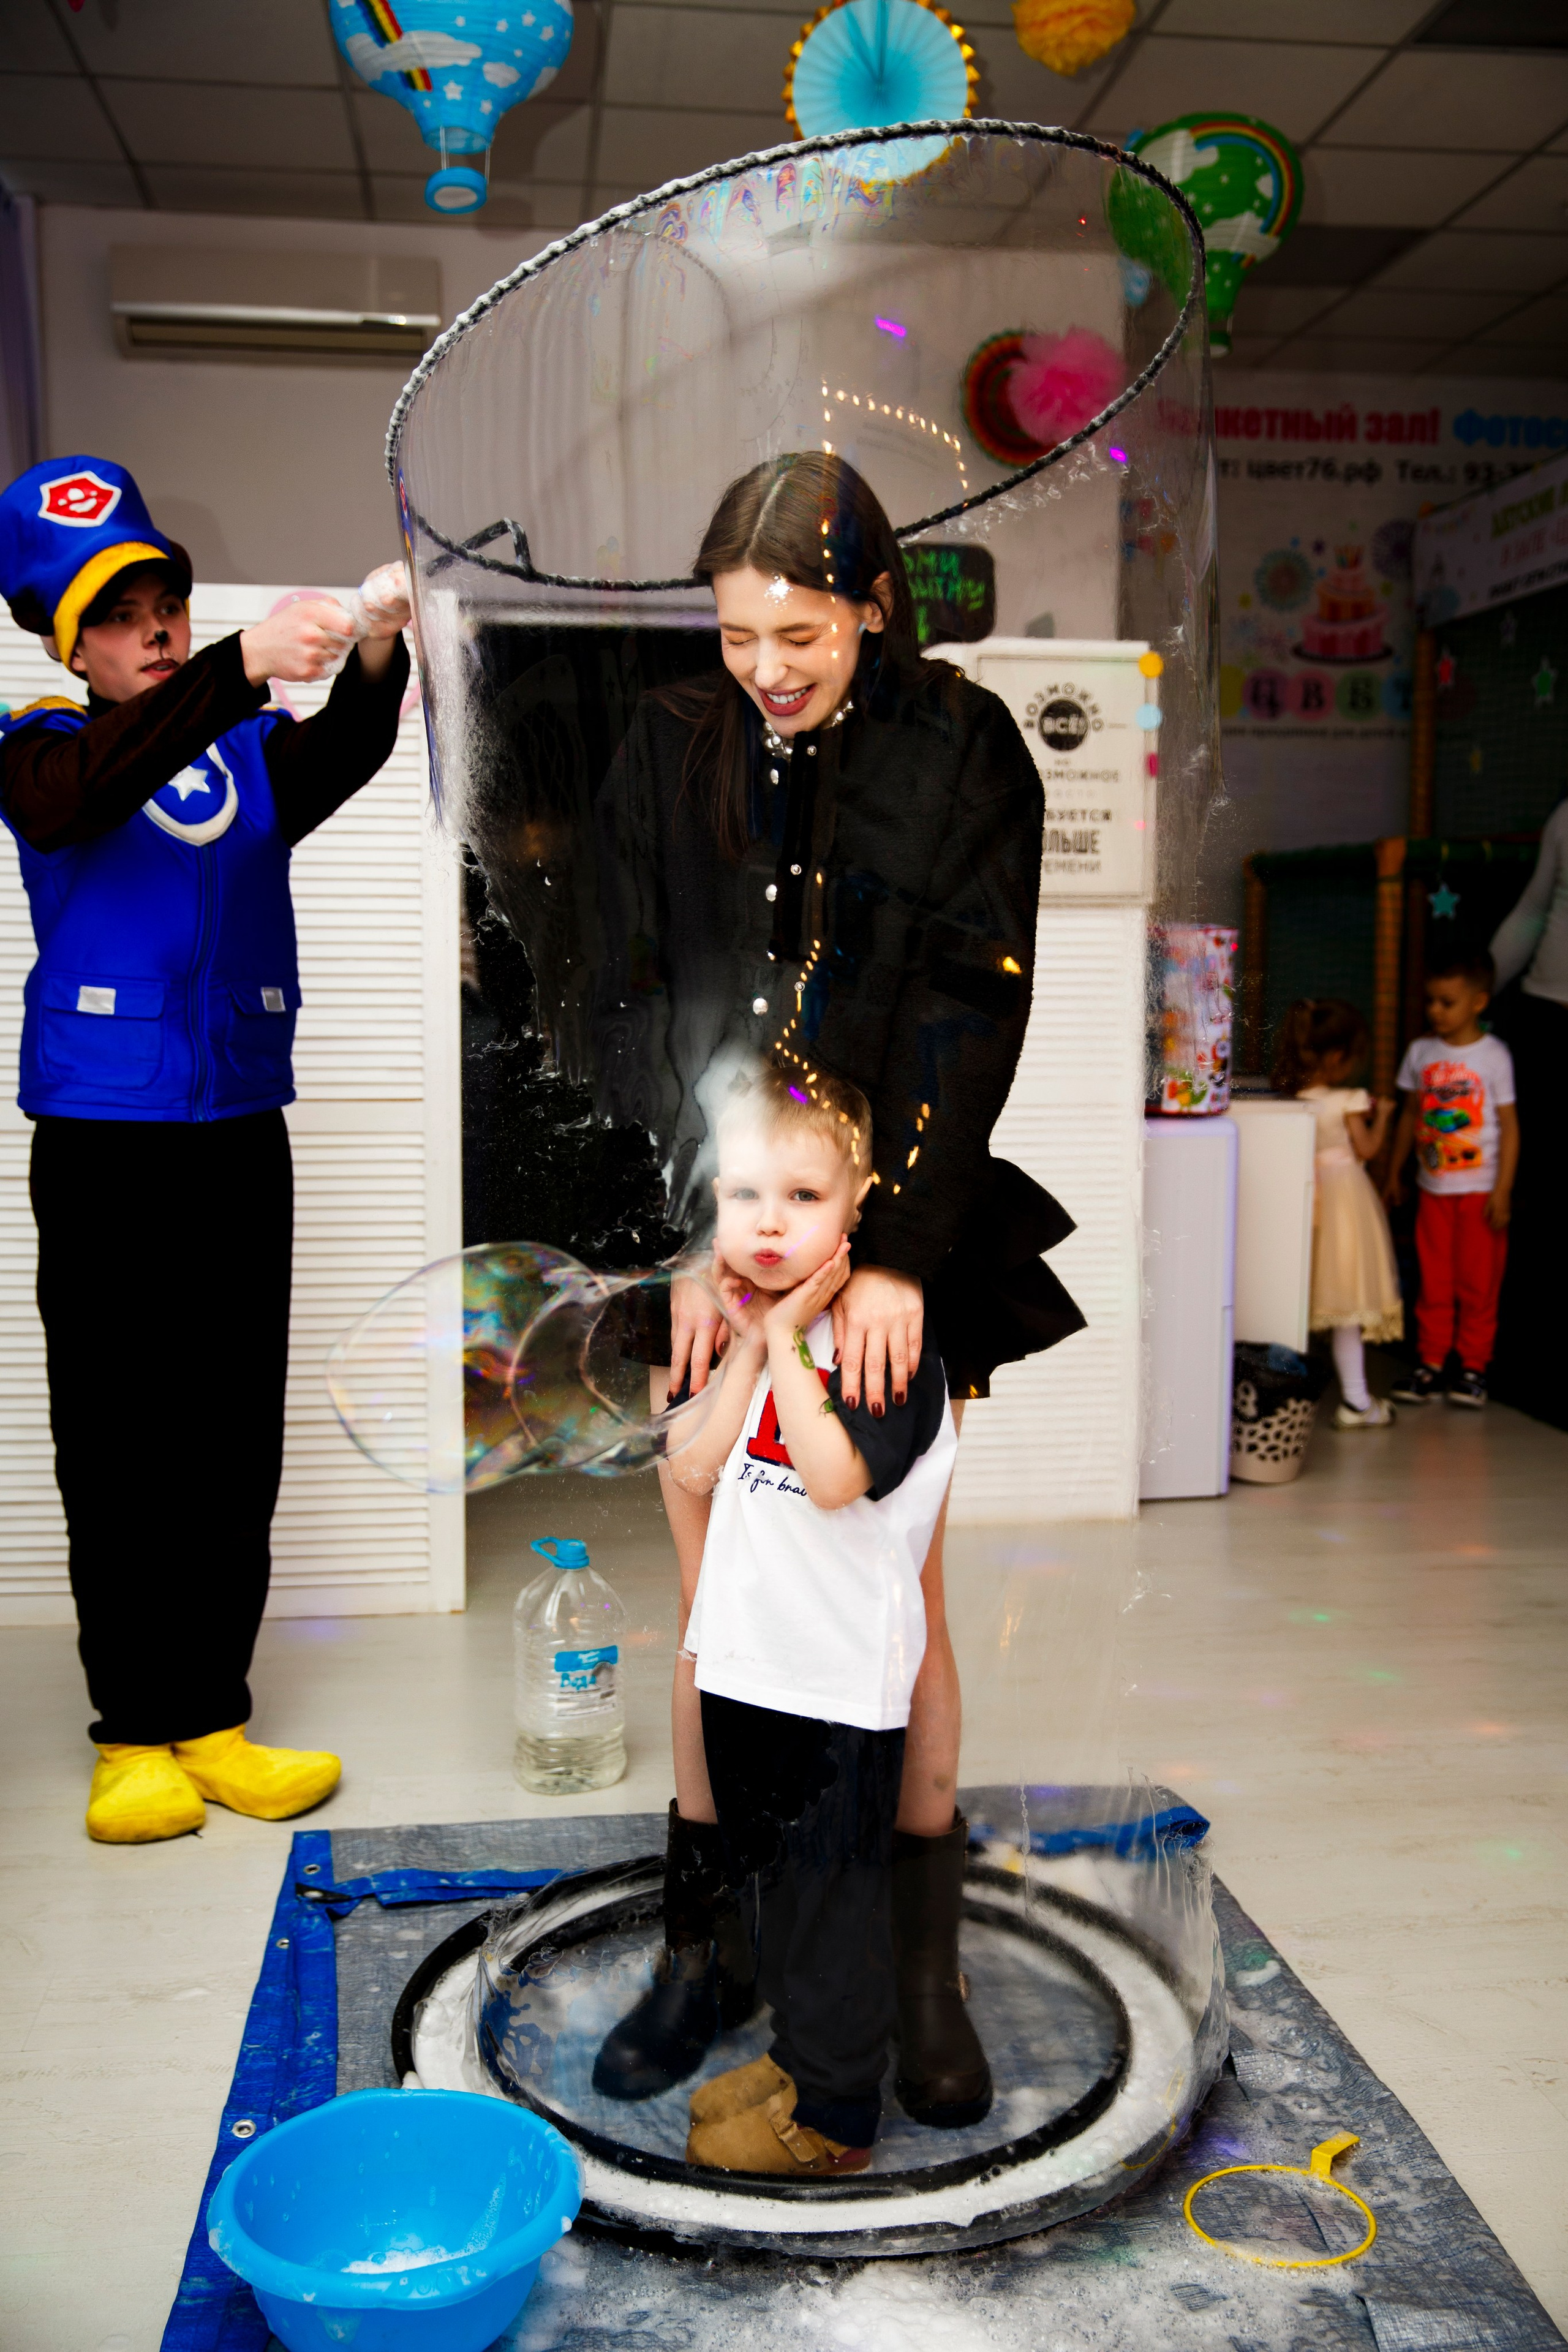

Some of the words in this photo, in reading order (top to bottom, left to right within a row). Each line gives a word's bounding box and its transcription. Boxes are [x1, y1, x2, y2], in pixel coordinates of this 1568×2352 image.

[1364, 406, 1439, 444] зал!
[1453, 409, 1568, 448] Фотос
[1046, 809, 1112, 823] БУЕТСЯ
[1042, 829, 1101, 854] ЛЬШЕ
[1044, 859, 1101, 874] ЕМЕНИ
[777, 1476, 807, 1496] brav
